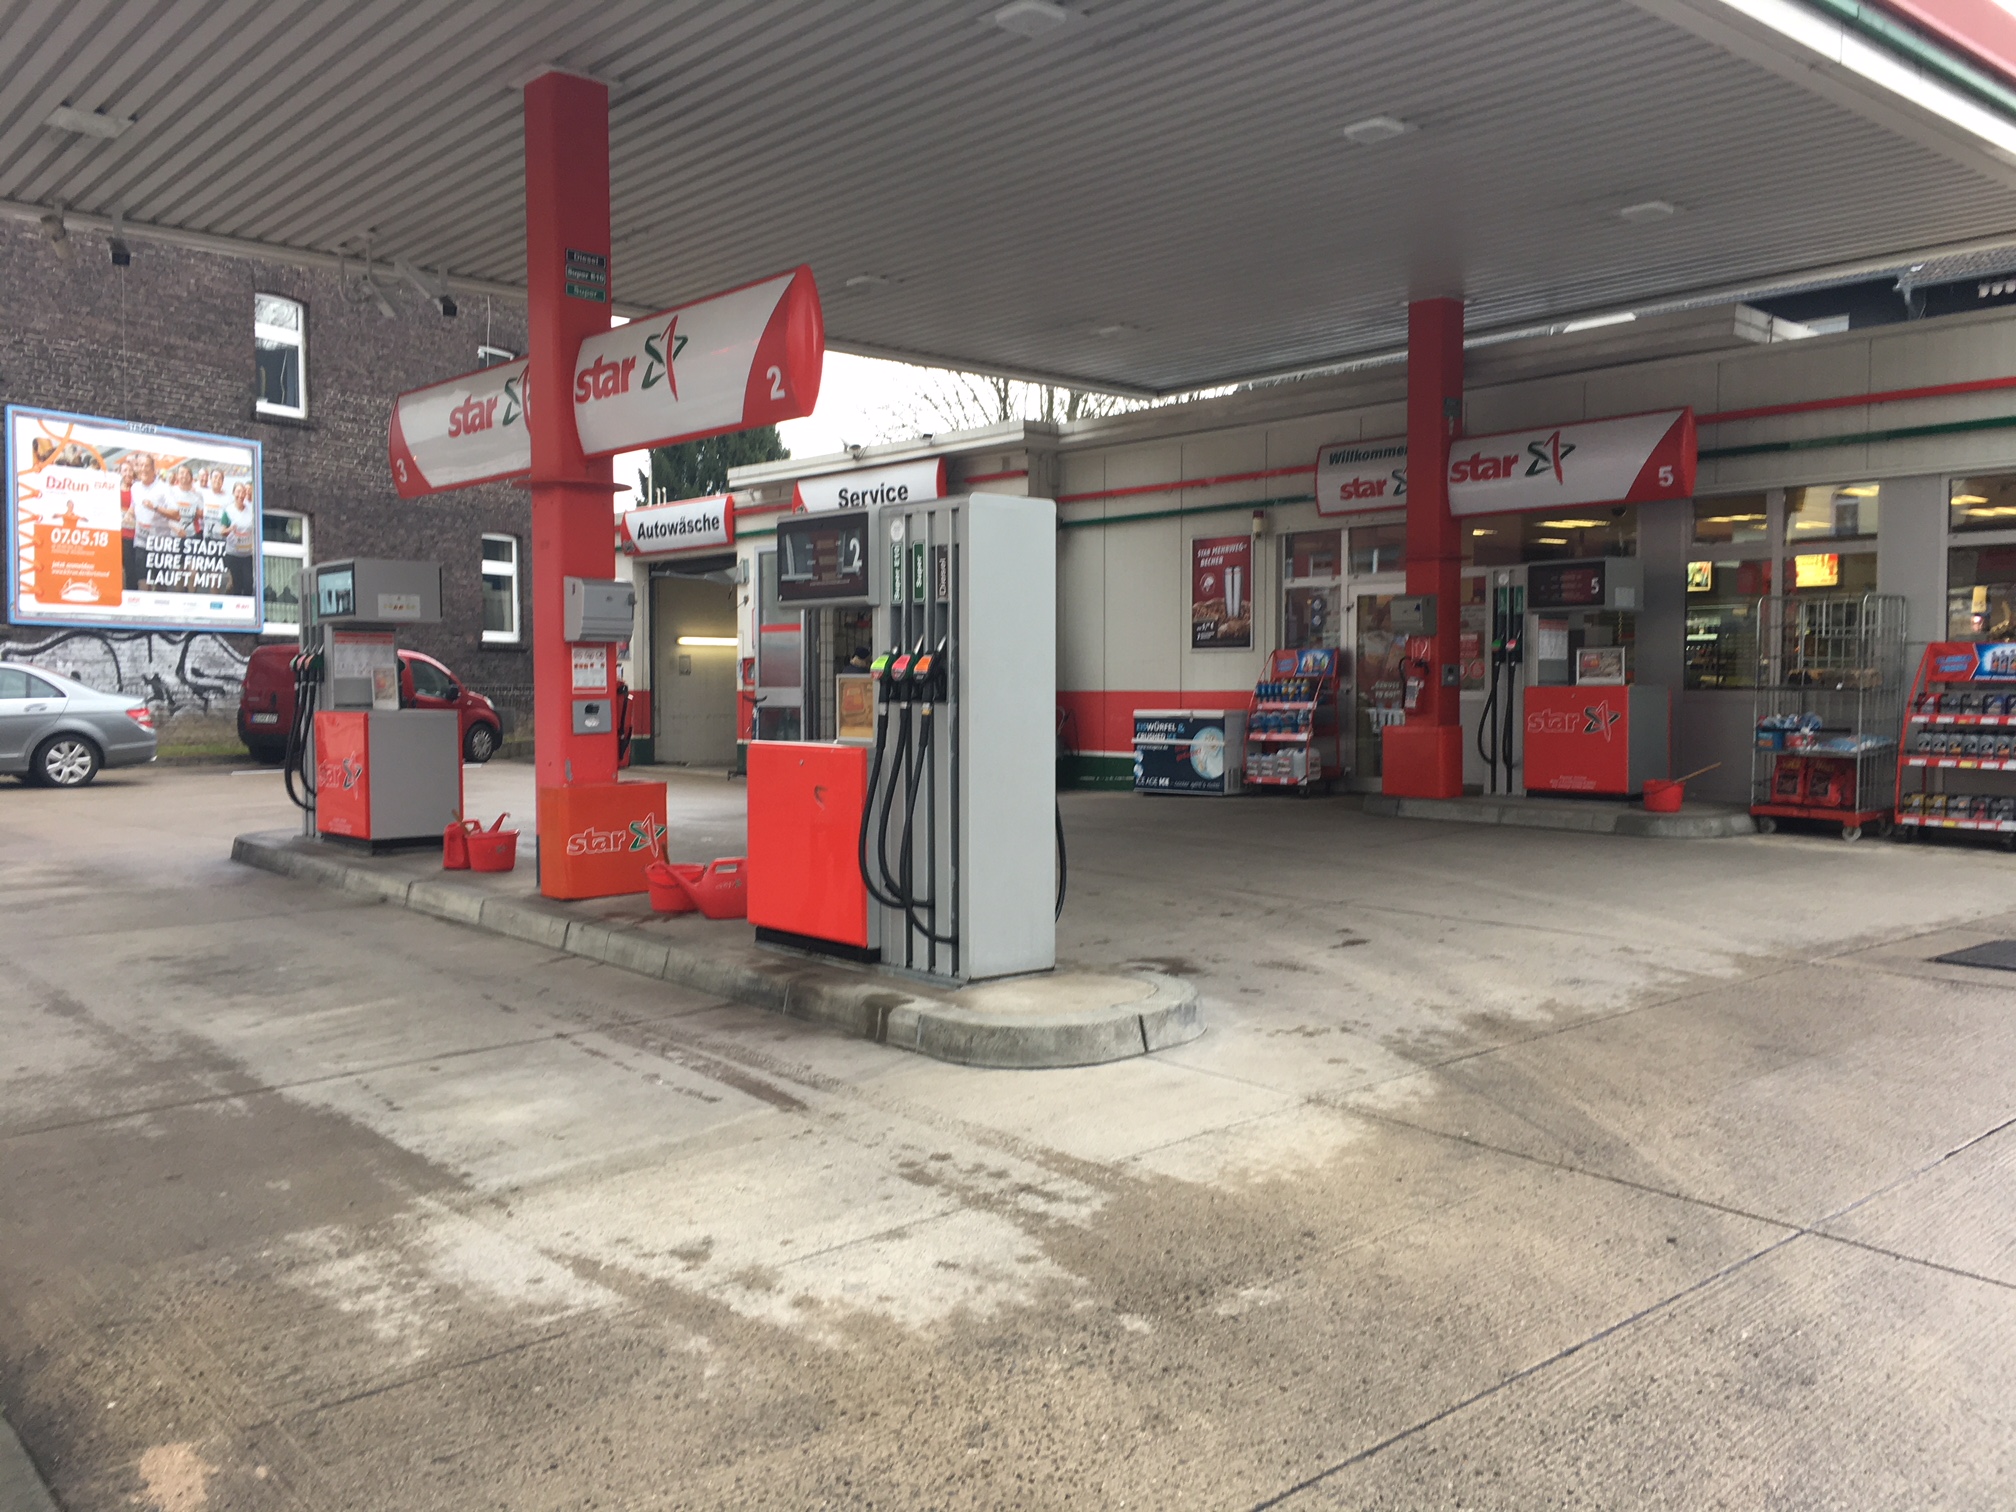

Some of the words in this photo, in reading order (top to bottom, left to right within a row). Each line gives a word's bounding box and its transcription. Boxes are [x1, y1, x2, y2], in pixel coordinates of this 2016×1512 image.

[573, 252, 599, 266] Diesel
[573, 285, 597, 299] Super
[576, 354, 637, 404] star
[766, 365, 786, 401] 2
[448, 394, 499, 438] star
[1329, 445, 1408, 466] Willkomme
[1449, 452, 1519, 484] star
[396, 458, 408, 484] 3
[1658, 466, 1674, 488] 5
[838, 482, 909, 508] Service
[1340, 476, 1387, 502] star
[50, 527, 110, 548] 07.05.18
[637, 512, 720, 541] Autowäsche
[146, 535, 181, 553] EURE
[146, 552, 181, 570] EURE
[915, 554, 923, 589] Super
[146, 569, 192, 587] LAUFT
[193, 572, 223, 589] MIT!
[893, 568, 902, 600] Super
[938, 557, 947, 596] Diesel
[1590, 577, 1600, 594] 5
[1528, 708, 1580, 734] star
[567, 827, 627, 856] star
